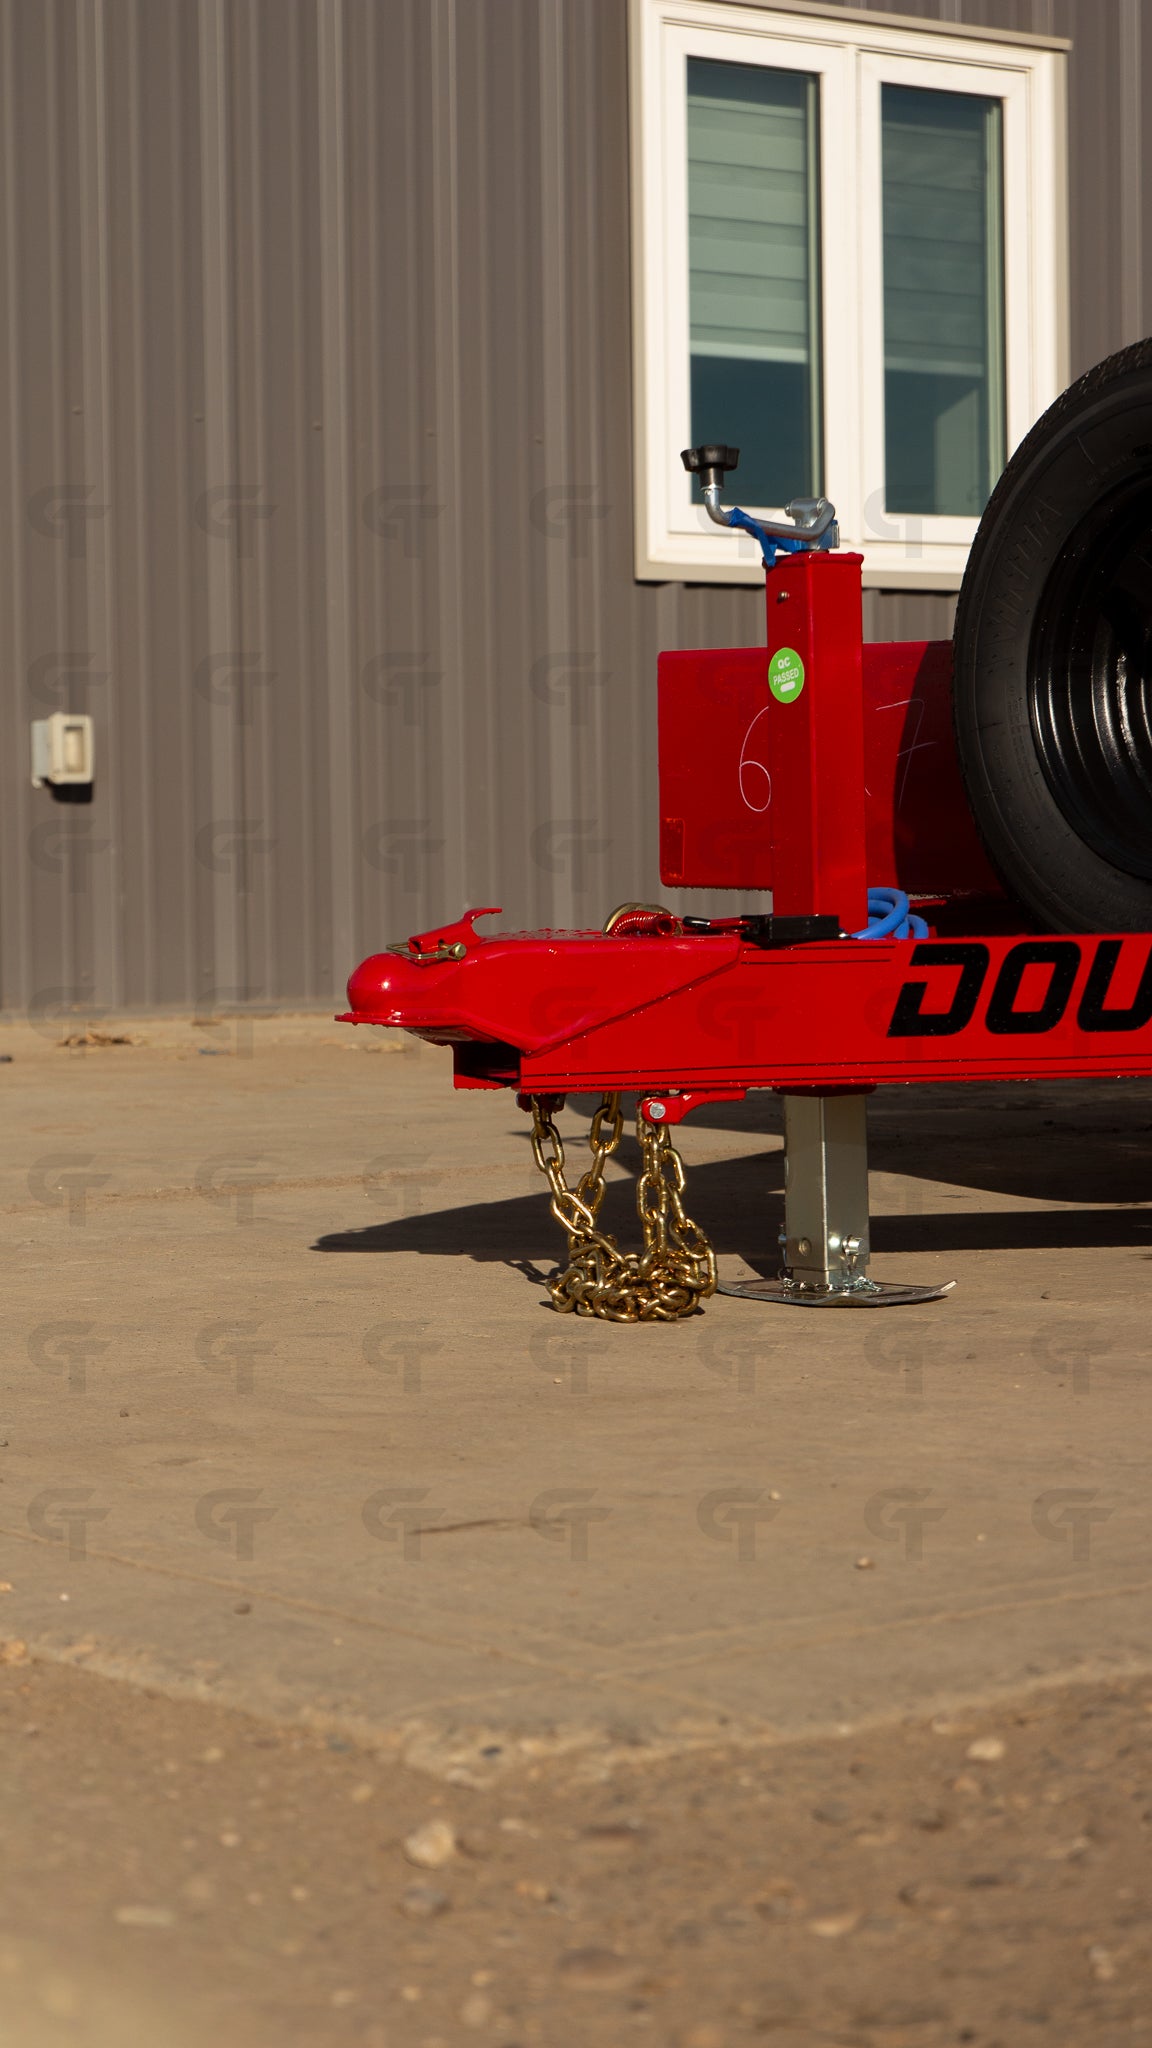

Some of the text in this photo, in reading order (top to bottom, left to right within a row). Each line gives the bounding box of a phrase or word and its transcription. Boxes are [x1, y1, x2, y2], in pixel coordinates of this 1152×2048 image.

[777, 656, 791, 669] QC
[773, 668, 800, 686] PASSED
[886, 939, 1152, 1038] DOU
